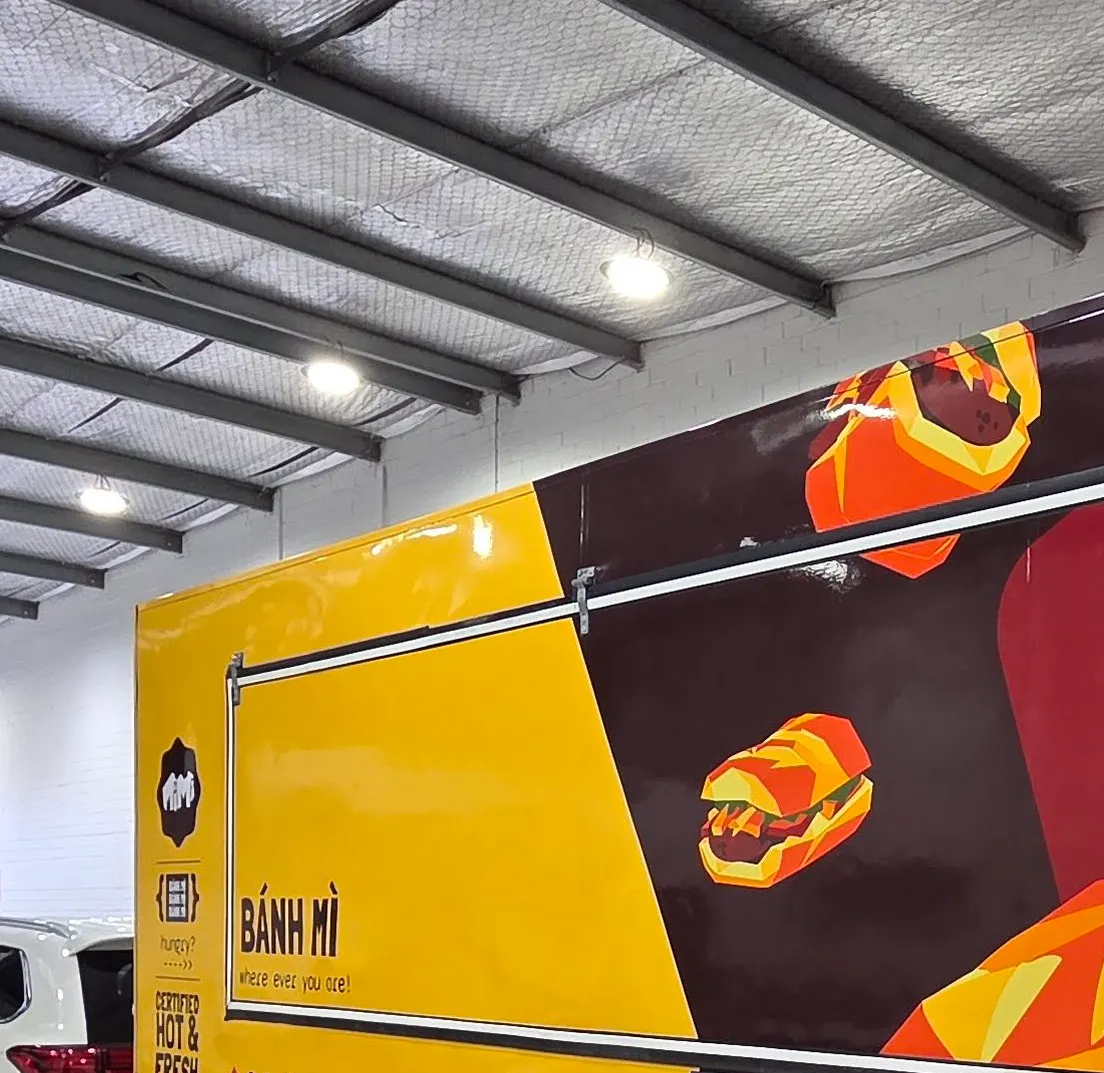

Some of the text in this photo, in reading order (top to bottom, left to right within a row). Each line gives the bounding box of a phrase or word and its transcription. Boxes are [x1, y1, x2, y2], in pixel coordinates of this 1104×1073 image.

[240, 882, 303, 955] BÁNH
[311, 880, 338, 957] MÌ
[160, 935, 196, 955] hungry?
[239, 967, 351, 994] where ever you are!
[155, 990, 200, 1014] CERTIFIED
[156, 1012, 199, 1052] HOT &
